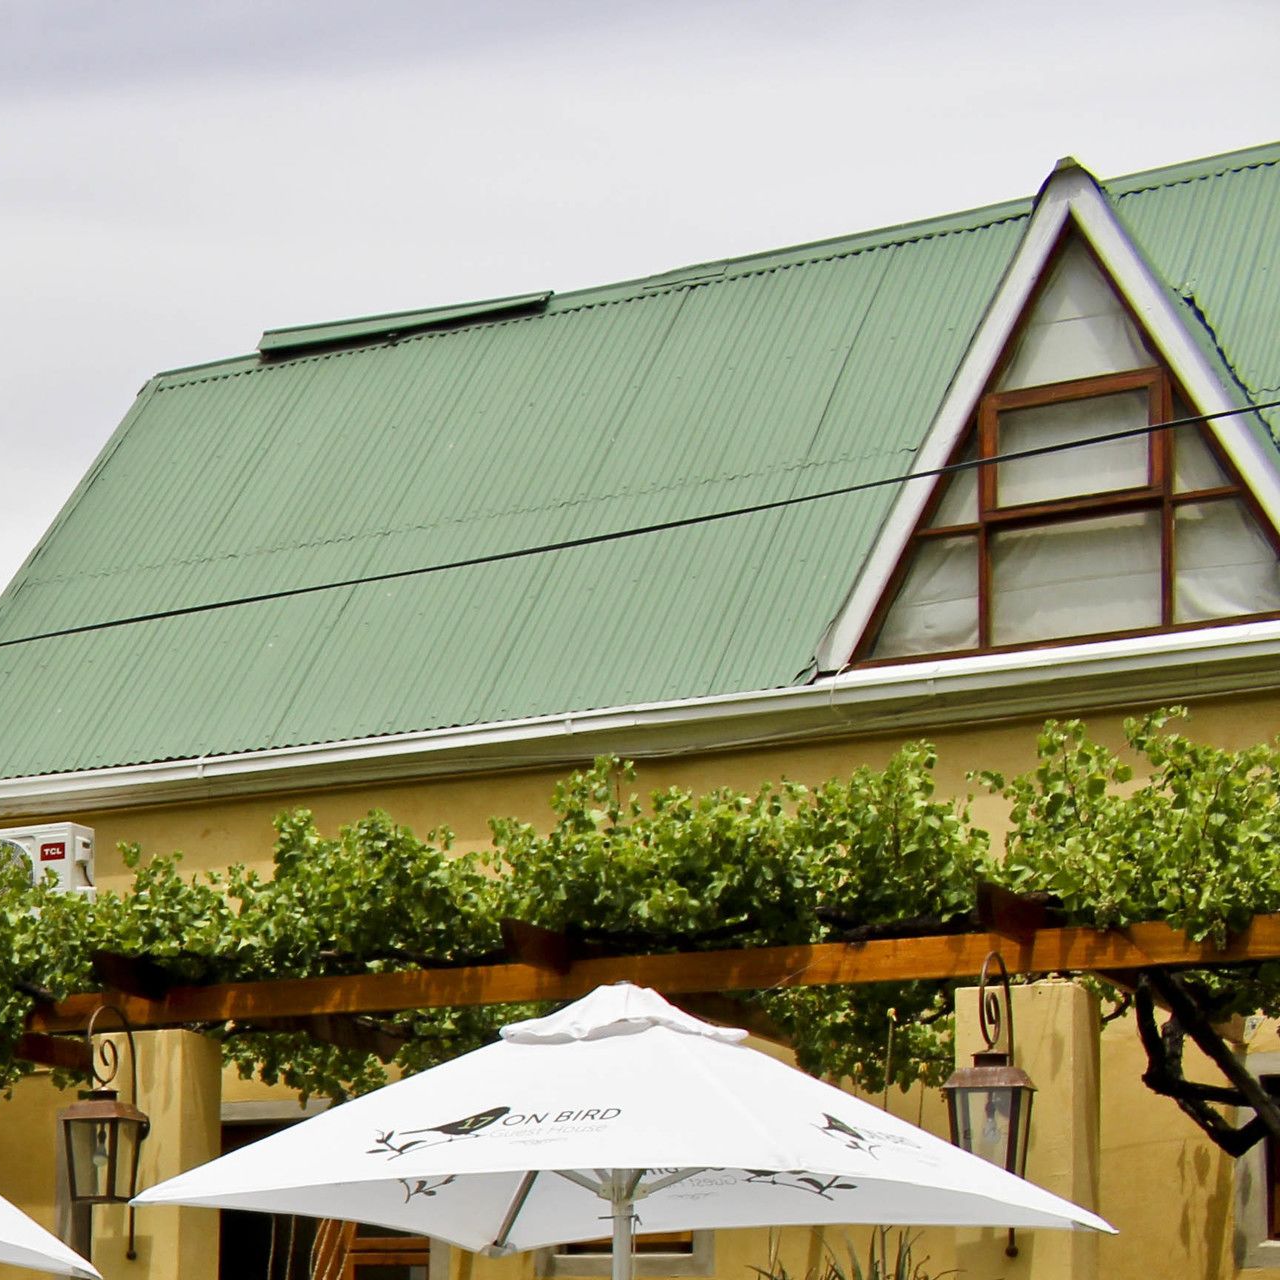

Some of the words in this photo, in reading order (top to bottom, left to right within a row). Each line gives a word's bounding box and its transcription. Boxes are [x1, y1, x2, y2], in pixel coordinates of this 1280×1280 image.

[457, 1116, 495, 1130] 17
[502, 1112, 549, 1126] ON
[553, 1108, 622, 1123] BIRD
